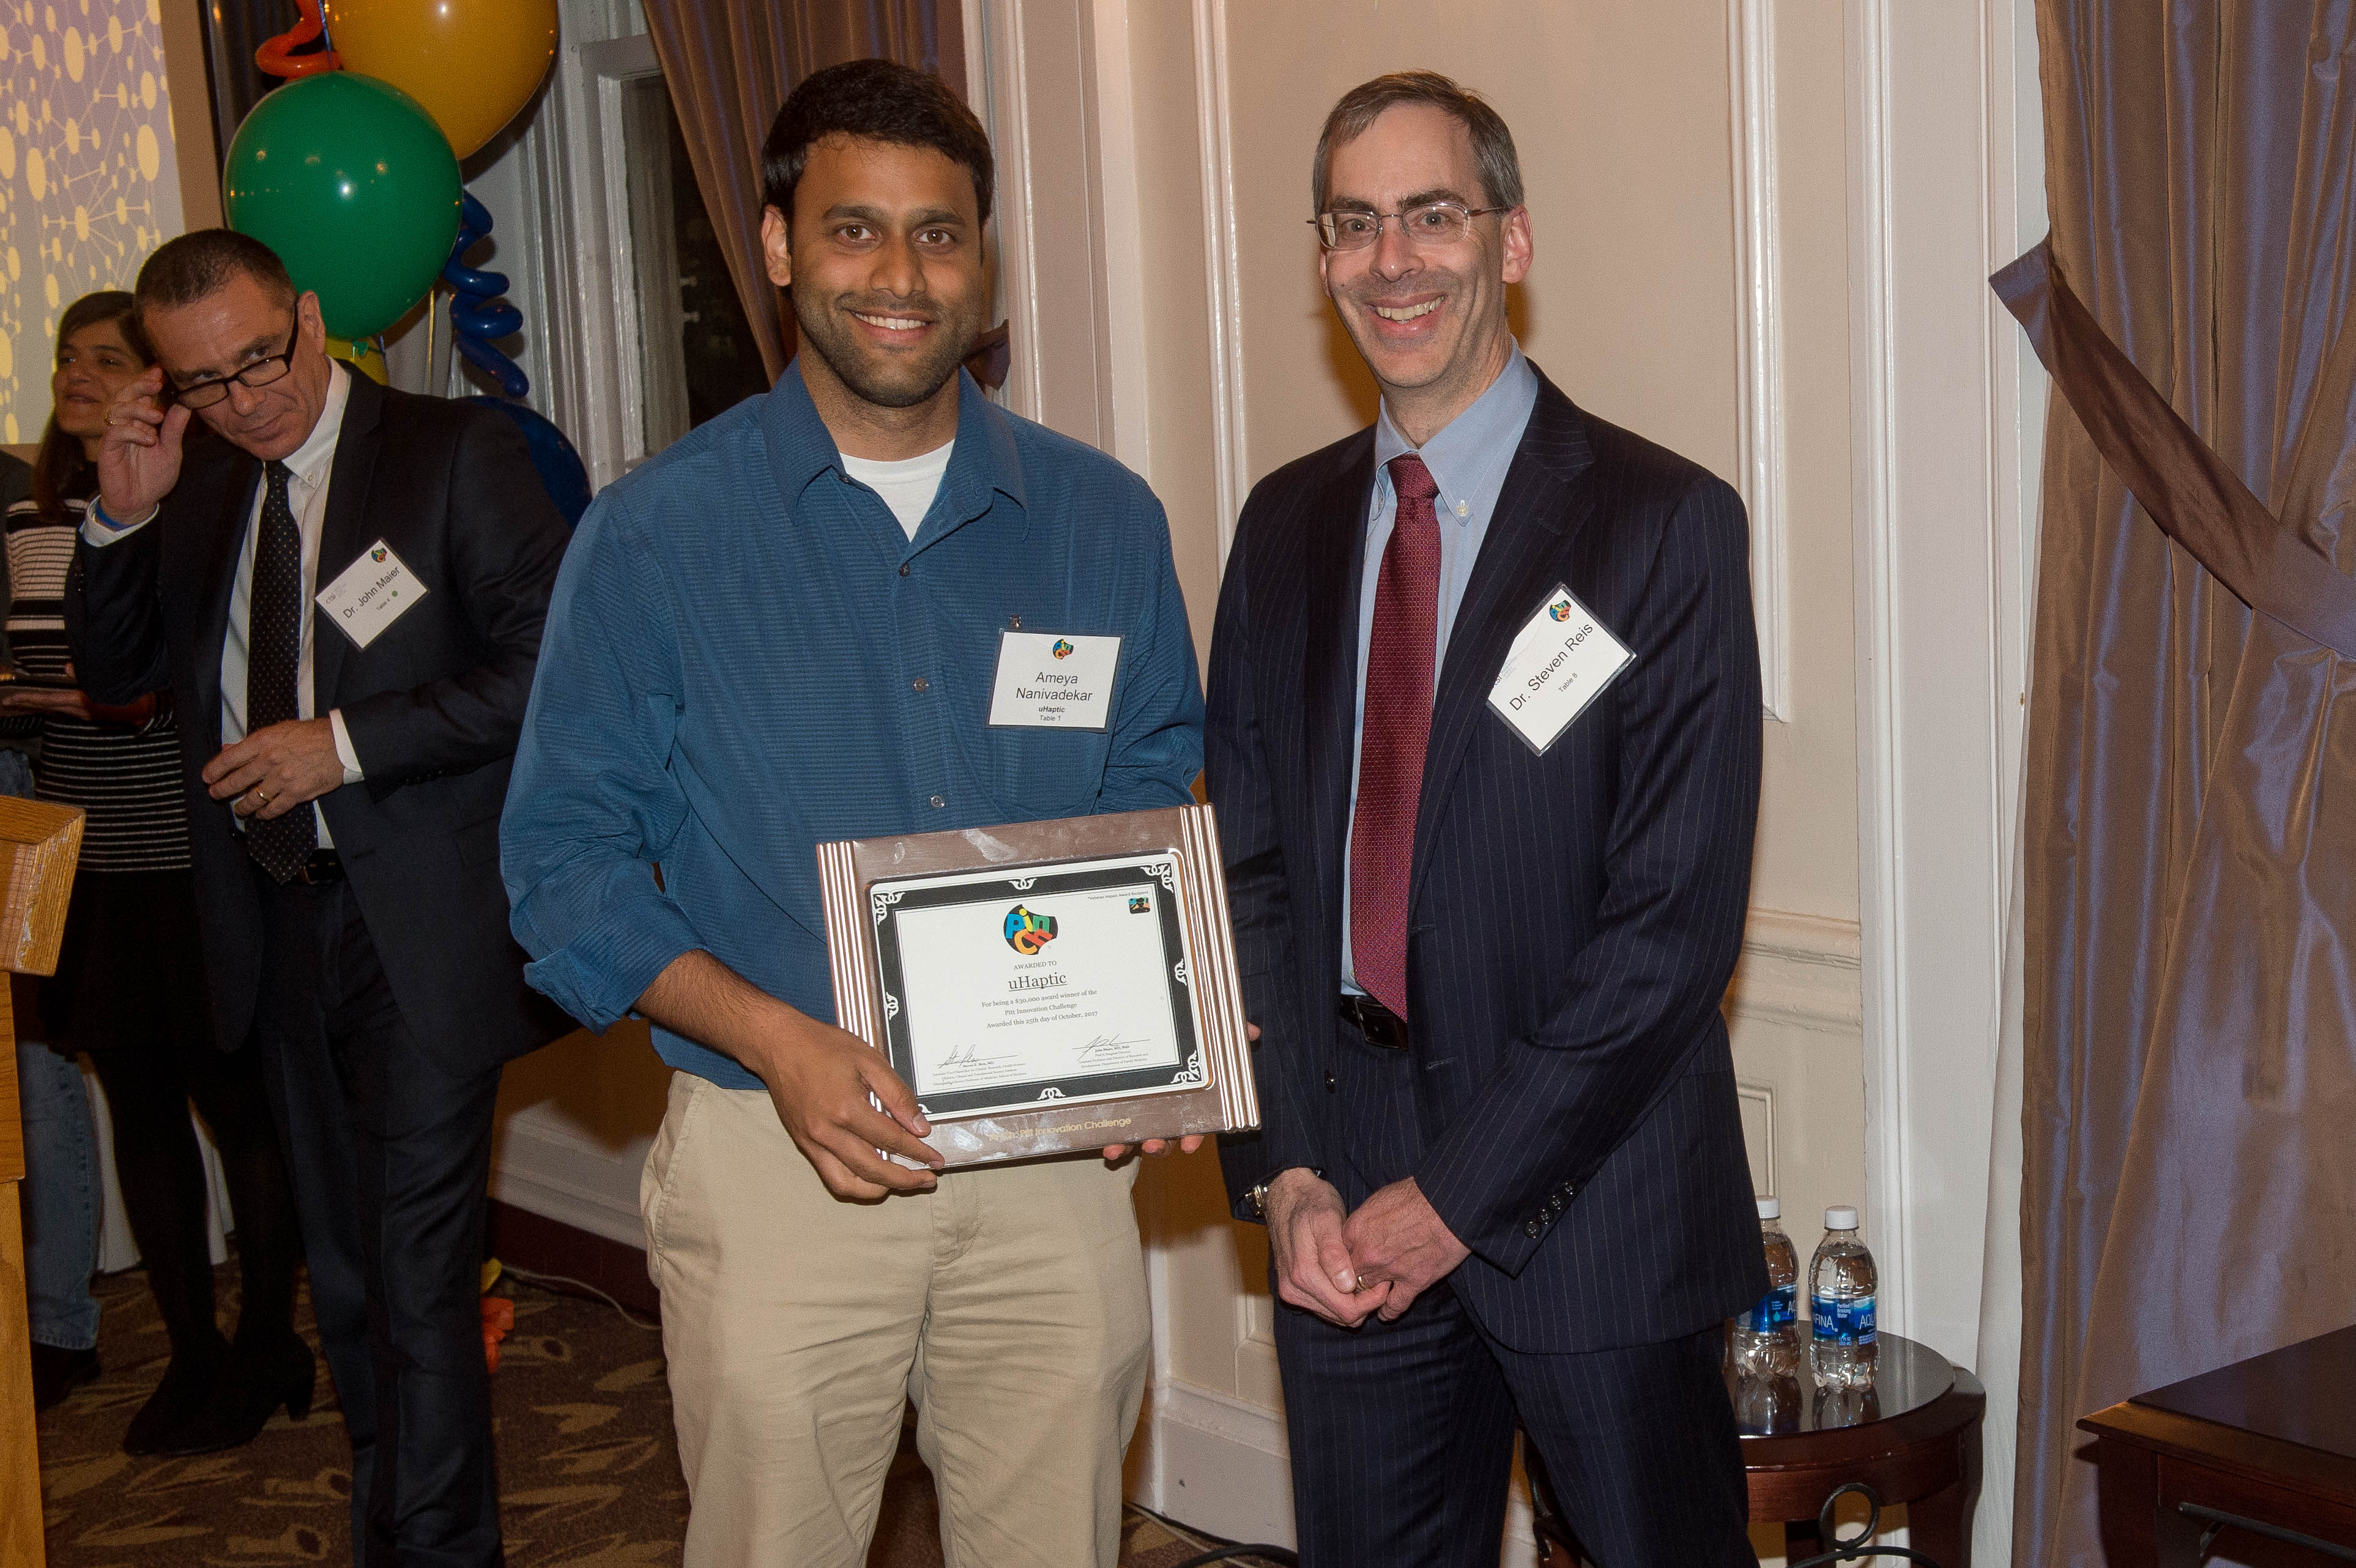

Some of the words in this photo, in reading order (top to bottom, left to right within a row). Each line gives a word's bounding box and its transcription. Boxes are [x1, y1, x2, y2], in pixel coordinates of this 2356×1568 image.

[343, 605, 360, 619] Dr.
[359, 587, 379, 607] John
[376, 567, 400, 590] Maier
[1509, 693, 1531, 711] Dr.
[1528, 650, 1568, 691] Steven
[1564, 623, 1594, 652] Reis
[1035, 671, 1079, 686] Ameya
[1558, 677, 1574, 693] Table
[1016, 688, 1093, 702] Nanivadekar
[1038, 705, 1065, 714] uHaptic
[1013, 961, 1047, 970] AWARDED
[1008, 972, 1067, 990] uHaptic
[992, 1000, 1009, 1008] being
[1016, 1006, 1048, 1015] Innovation
[1049, 1003, 1078, 1011] Challenge
[986, 1019, 1013, 1028] Awarded
[1058, 1011, 1083, 1020] October,
[1035, 1122, 1082, 1136] Innovation
[1084, 1118, 1132, 1129] Challenge
